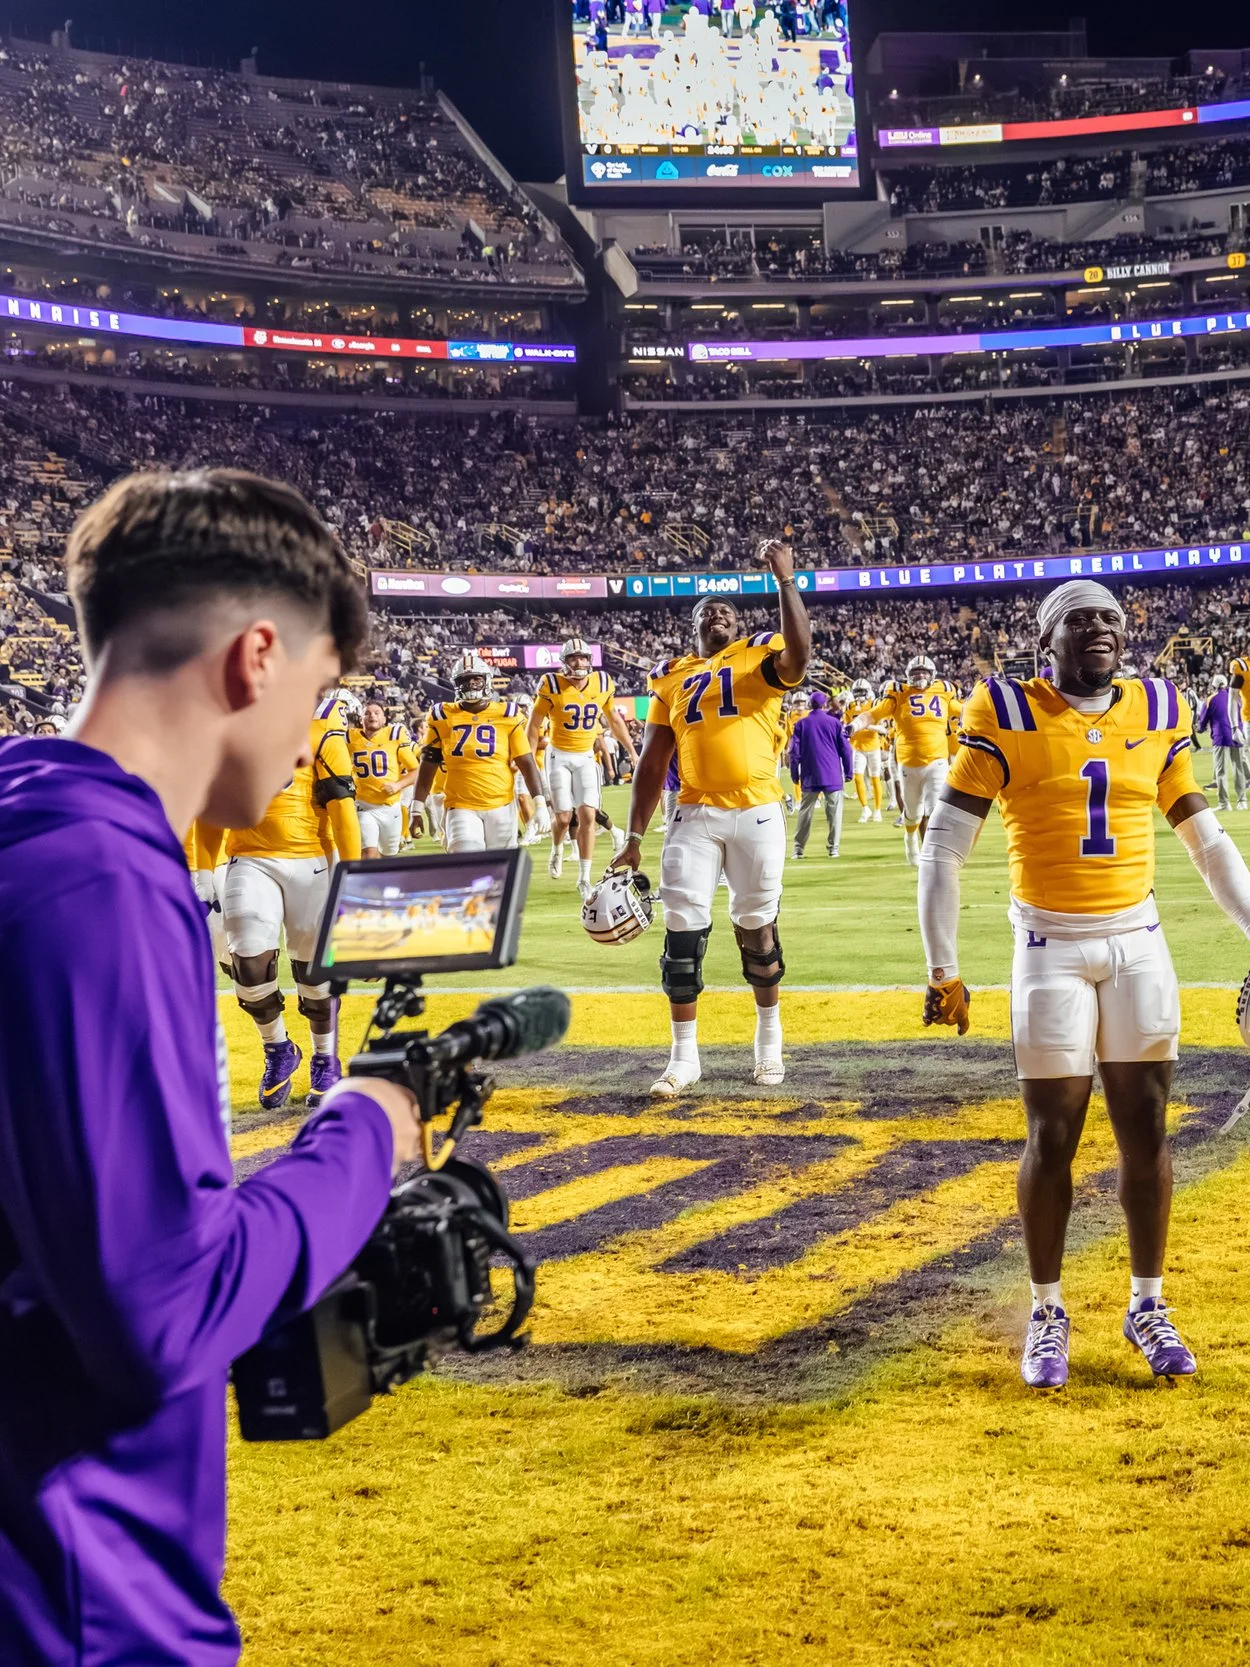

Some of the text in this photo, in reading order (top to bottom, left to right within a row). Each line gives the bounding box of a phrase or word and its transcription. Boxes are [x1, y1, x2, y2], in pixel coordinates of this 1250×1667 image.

[585, 144, 598, 155] V
[603, 144, 612, 154] 0
[762, 165, 793, 177] COX
[1089, 262, 1170, 280] 20 BILLY CANNON
[8, 299, 120, 330] NNAISE
[1111, 322, 1181, 340] BLUE
[633, 347, 684, 356] NISSAN
[859, 568, 931, 587] BLUE
[953, 561, 1045, 582] PLATE
[1070, 554, 1143, 574] REAL
[608, 579, 624, 594] V
[632, 579, 644, 594] 0
[797, 576, 808, 589] 0
[683, 667, 739, 726] 71
[909, 694, 943, 717] 54
[563, 702, 599, 731] 38
[451, 723, 497, 758] 79
[353, 750, 389, 779] 50
[1079, 758, 1117, 858] 1
